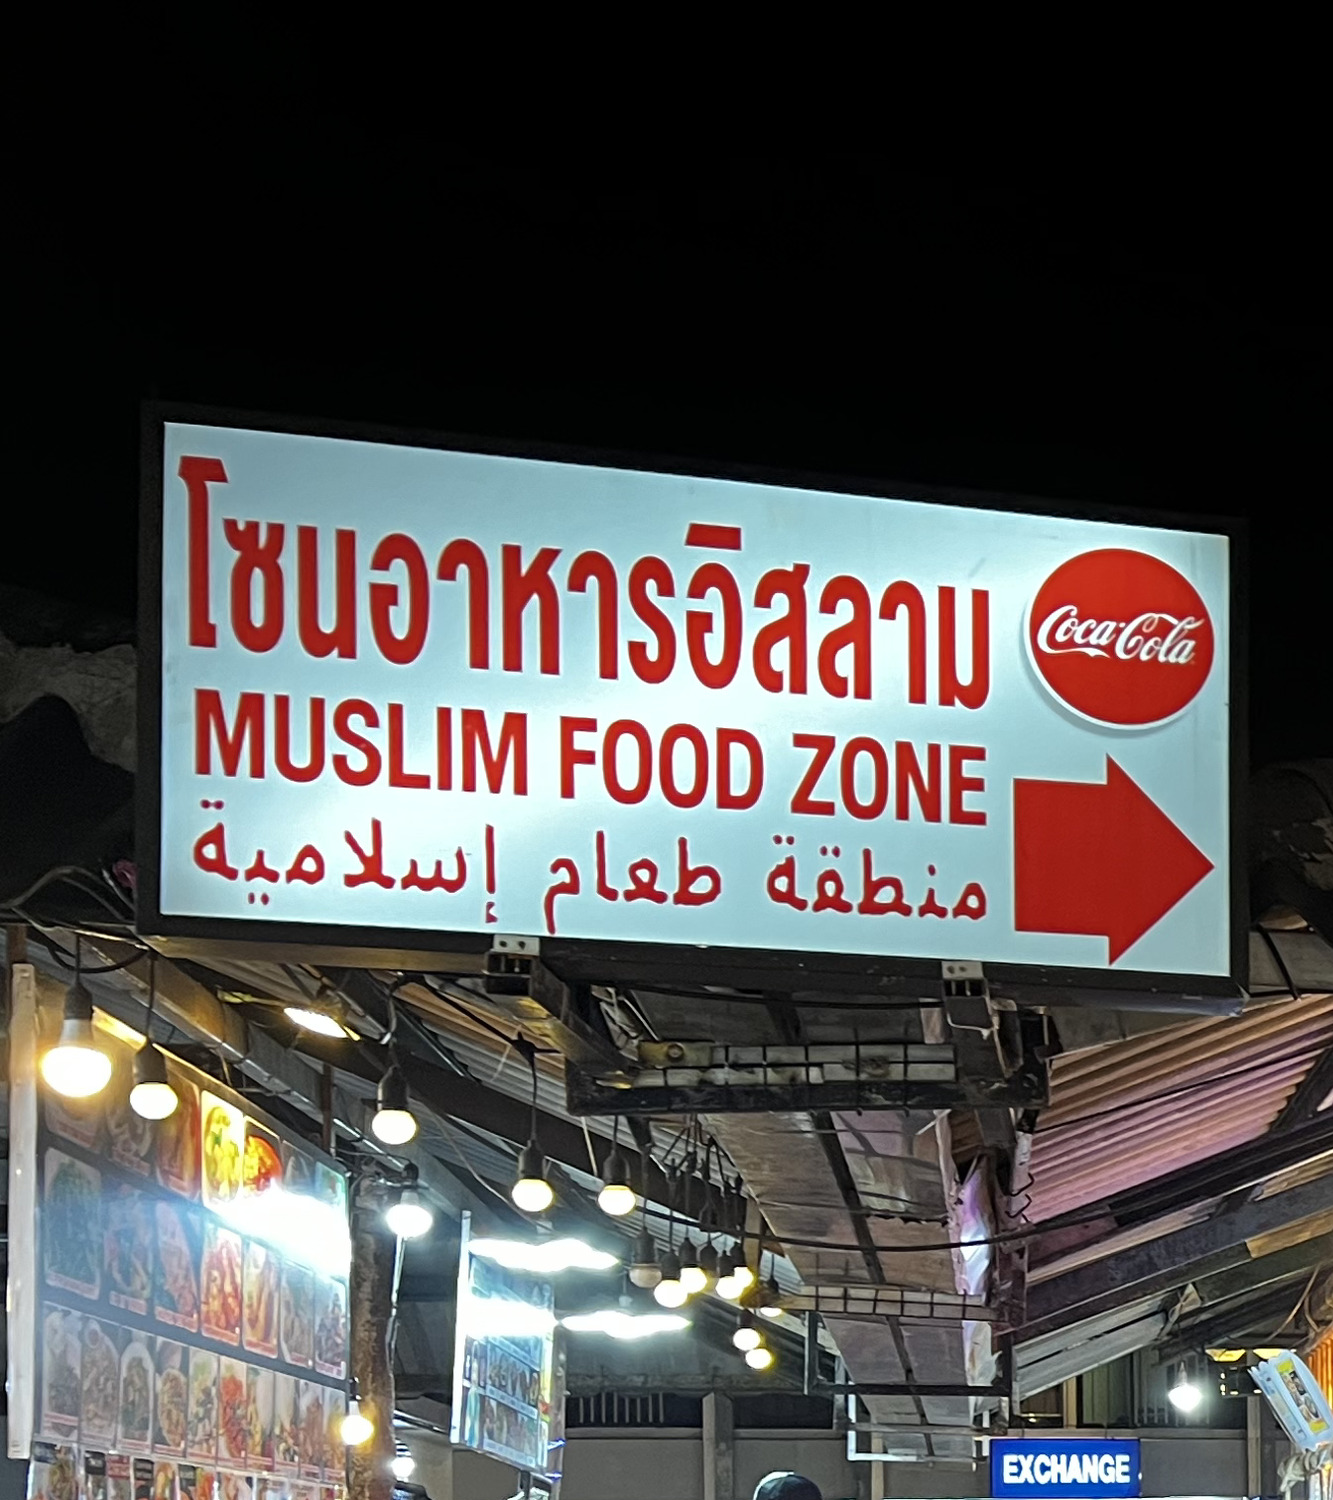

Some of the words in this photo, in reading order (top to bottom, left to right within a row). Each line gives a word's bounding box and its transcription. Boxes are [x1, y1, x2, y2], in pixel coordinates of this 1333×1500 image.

[178, 455, 990, 710] โซนอาหารอิสลาม
[1037, 603, 1197, 666] Coca-Cola
[195, 689, 528, 797] MUSLIM
[560, 716, 764, 810] FOOD
[790, 733, 988, 826] ZONE
[193, 800, 498, 923] إسلامية
[543, 830, 722, 935] طعام
[766, 835, 987, 921] منطقة
[1003, 1453, 1131, 1485] EXCHANGE
